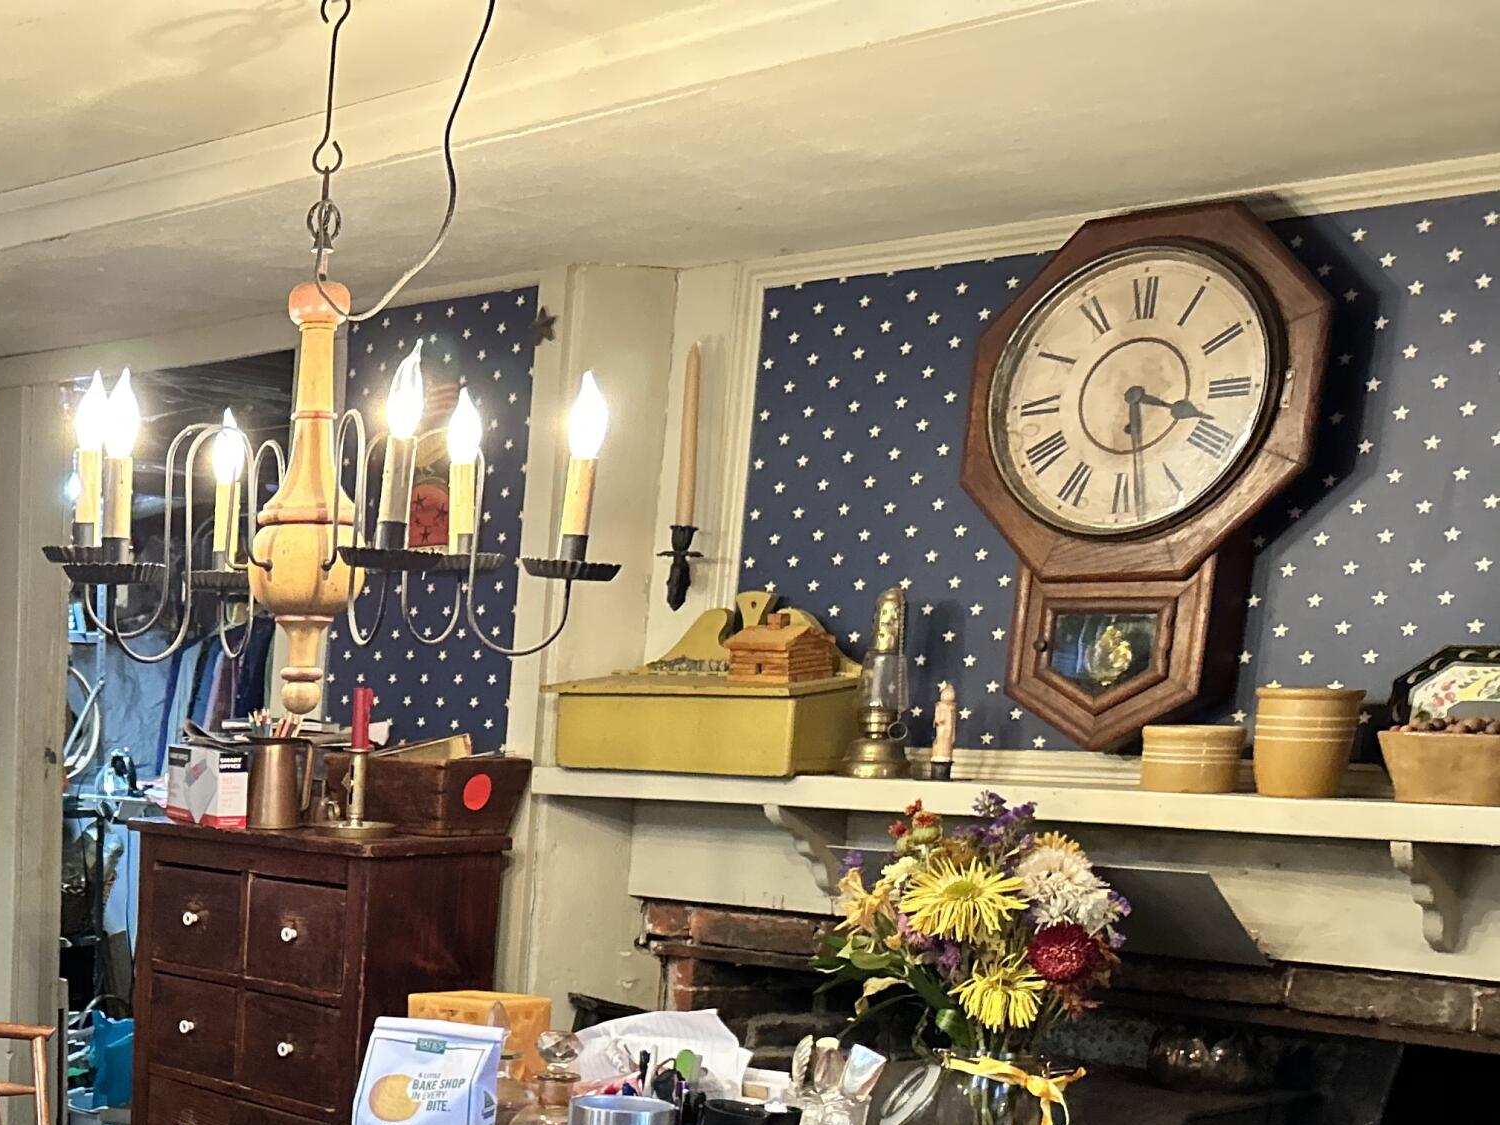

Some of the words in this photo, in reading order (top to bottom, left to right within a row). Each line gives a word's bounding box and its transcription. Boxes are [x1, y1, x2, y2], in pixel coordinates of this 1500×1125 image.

[411, 1079, 438, 1091] BAKE
[438, 1078, 466, 1089] SHOP
[411, 1091, 421, 1100] IN
[422, 1090, 447, 1100] EVERY
